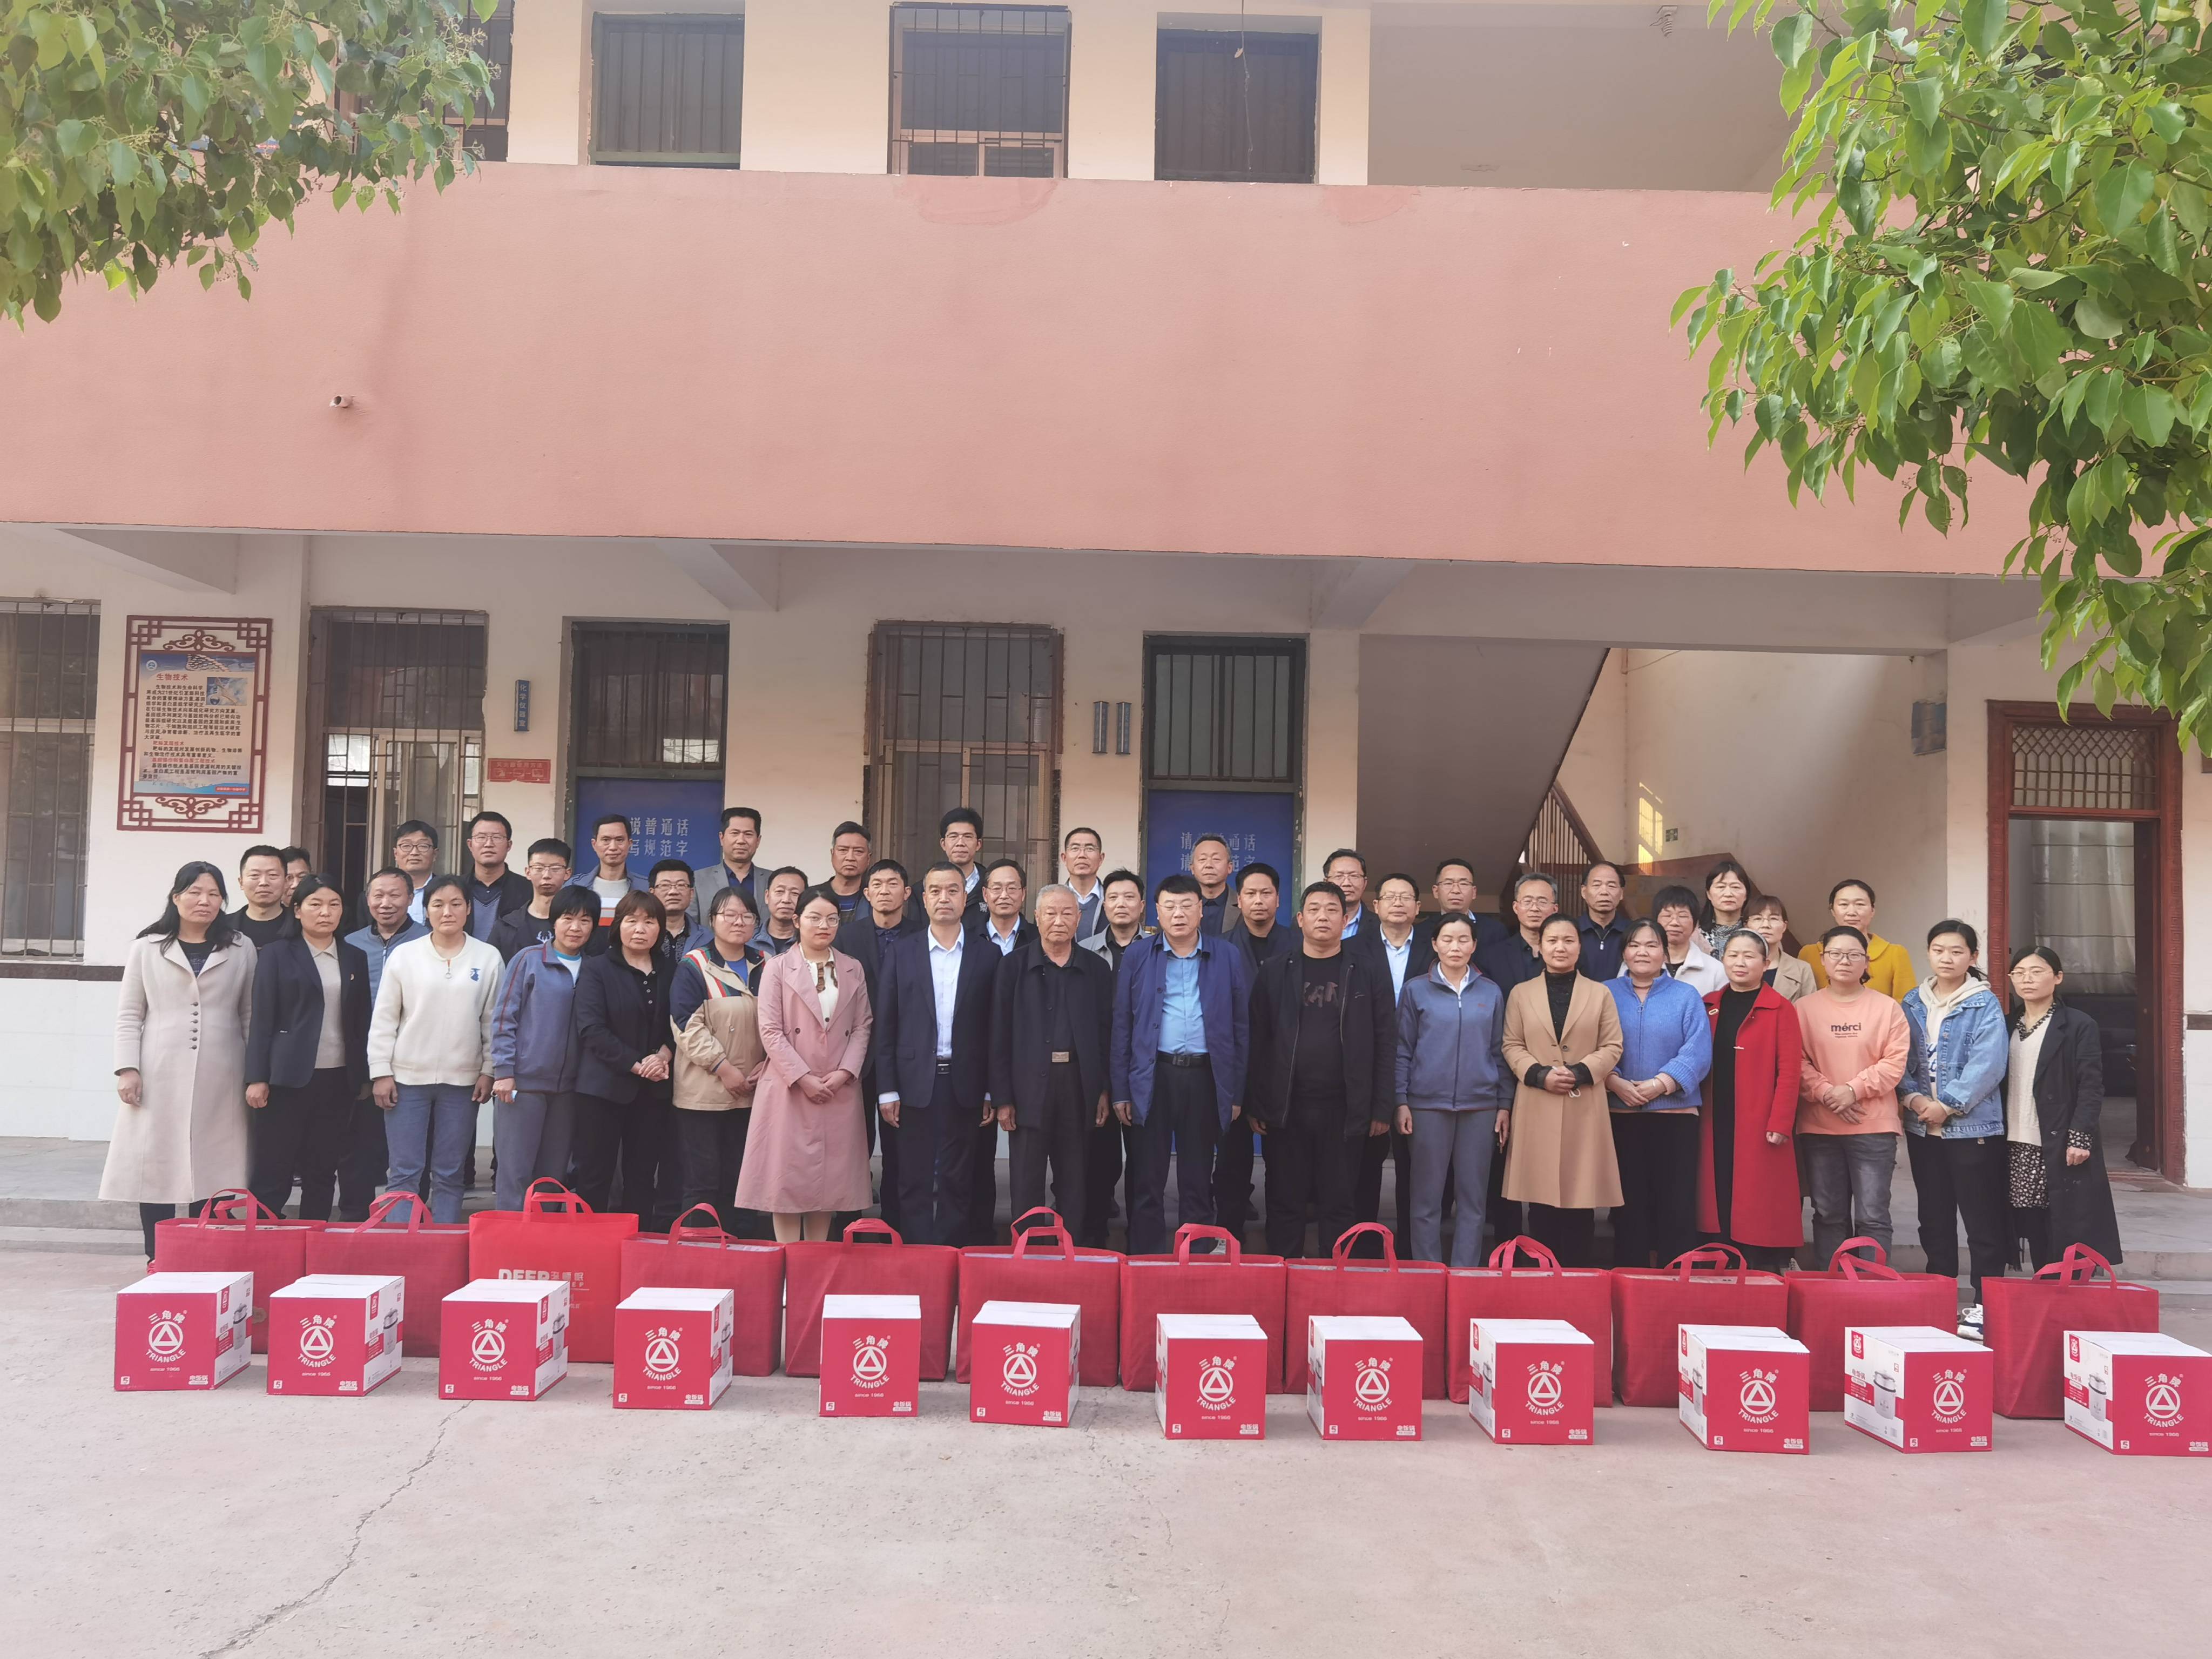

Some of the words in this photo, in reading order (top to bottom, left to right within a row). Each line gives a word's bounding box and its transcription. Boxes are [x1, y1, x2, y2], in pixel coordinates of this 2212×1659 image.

[518, 684, 527, 727] 化学仪器室
[630, 817, 689, 836] 说普通话
[629, 839, 688, 857] 写规范字
[1181, 832, 1256, 851] 请通话
[498, 1269, 550, 1280] DEEP
[149, 1310, 185, 1324] 三角牌
[300, 1315, 335, 1328] 三角牌
[472, 1319, 507, 1332] 三角牌
[645, 1327, 680, 1341] 三角牌
[853, 1336, 888, 1349] 三角牌
[146, 1348, 186, 1363] TRIANGLE
[1003, 1343, 1038, 1357] 三角牌
[298, 1353, 336, 1367] TRIANGLE
[469, 1357, 507, 1372] TRIANGLE
[1199, 1356, 1235, 1370] 三角牌
[1355, 1357, 1391, 1371] 三角牌
[643, 1366, 682, 1381] TRIANGLE
[1527, 1361, 1562, 1374] 三角牌
[851, 1374, 889, 1388] TRIANGLE
[1739, 1368, 1777, 1382] 三角牌
[1933, 1369, 1965, 1383] 三角牌
[2145, 1373, 2181, 1387] 三角牌
[1001, 1380, 1039, 1396] TRIANGLE
[1197, 1395, 1236, 1411] TRIANGLE
[1353, 1397, 1392, 1412] TRIANGLE
[1526, 1400, 1564, 1415] TRIANGLE
[1738, 1408, 1778, 1424] TRIANGLE
[1932, 1409, 1966, 1424] TRIANGLE
[2144, 1413, 2184, 1427] TRIANGLE
[1174, 1424, 1180, 1432] 5
[1716, 1437, 1722, 1445] 5
[1911, 1439, 1917, 1447] 5
[2122, 1440, 2128, 1449] 5
